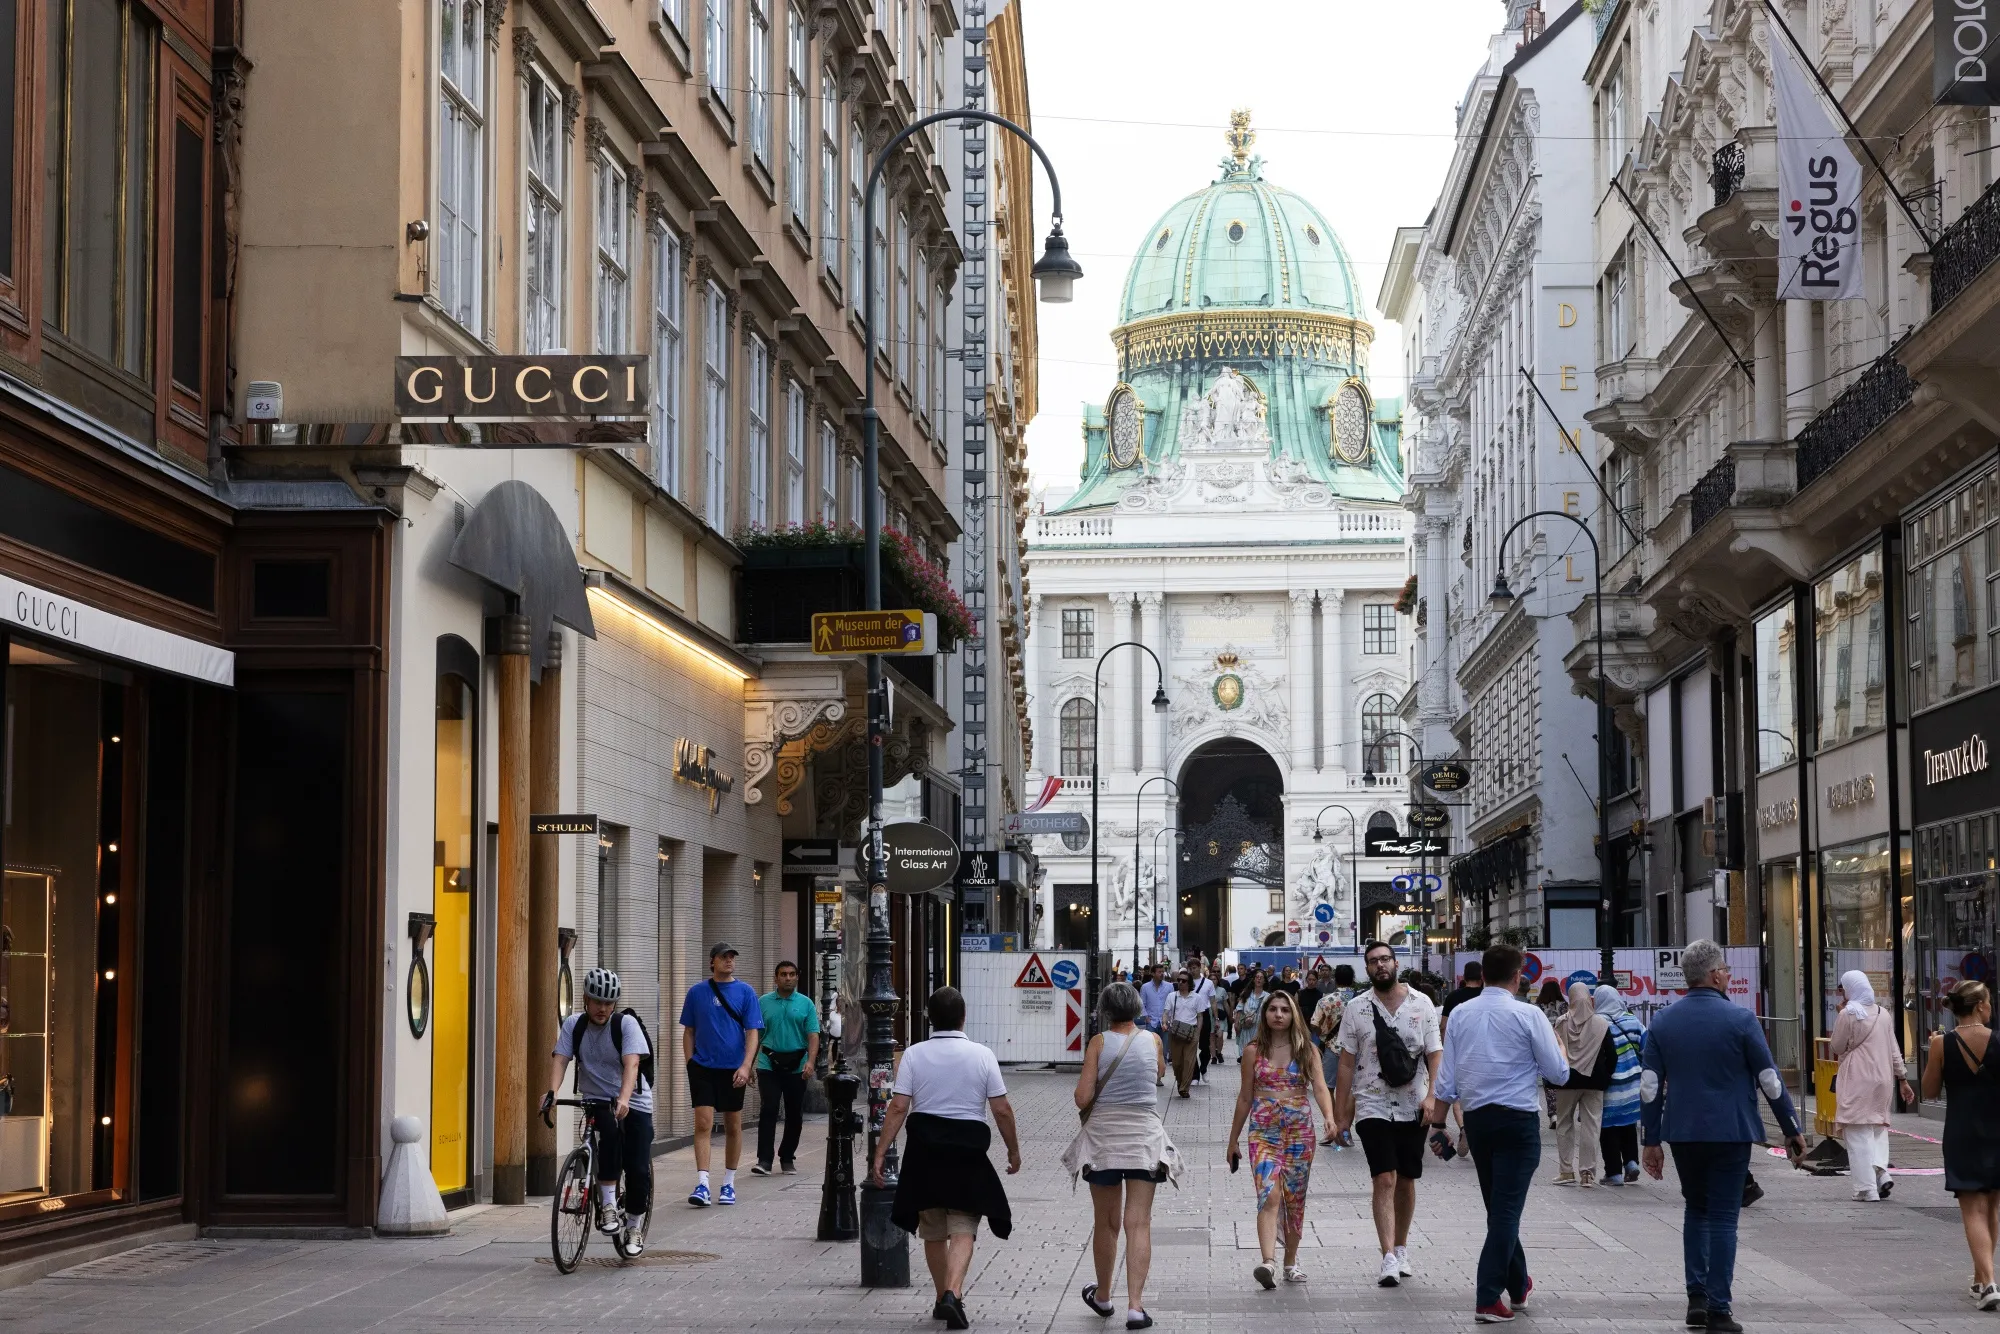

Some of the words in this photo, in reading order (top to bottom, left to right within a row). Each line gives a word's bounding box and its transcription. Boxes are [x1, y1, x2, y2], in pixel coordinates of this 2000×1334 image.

[1800, 155, 1857, 288] Regus
[407, 365, 636, 404] GUCCI
[16, 591, 78, 639] GUCCI
[835, 619, 881, 631] Museum
[884, 617, 903, 630] der
[841, 634, 897, 647] Illusionen
[1432, 771, 1460, 779] DEMEL
[537, 823, 593, 833] SCHULLIN
[1008, 817, 1079, 831] APOTHEKE
[895, 846, 953, 857] International
[900, 859, 929, 870] Glass
[931, 859, 948, 870] Art
[1731, 977, 1749, 986] seit
